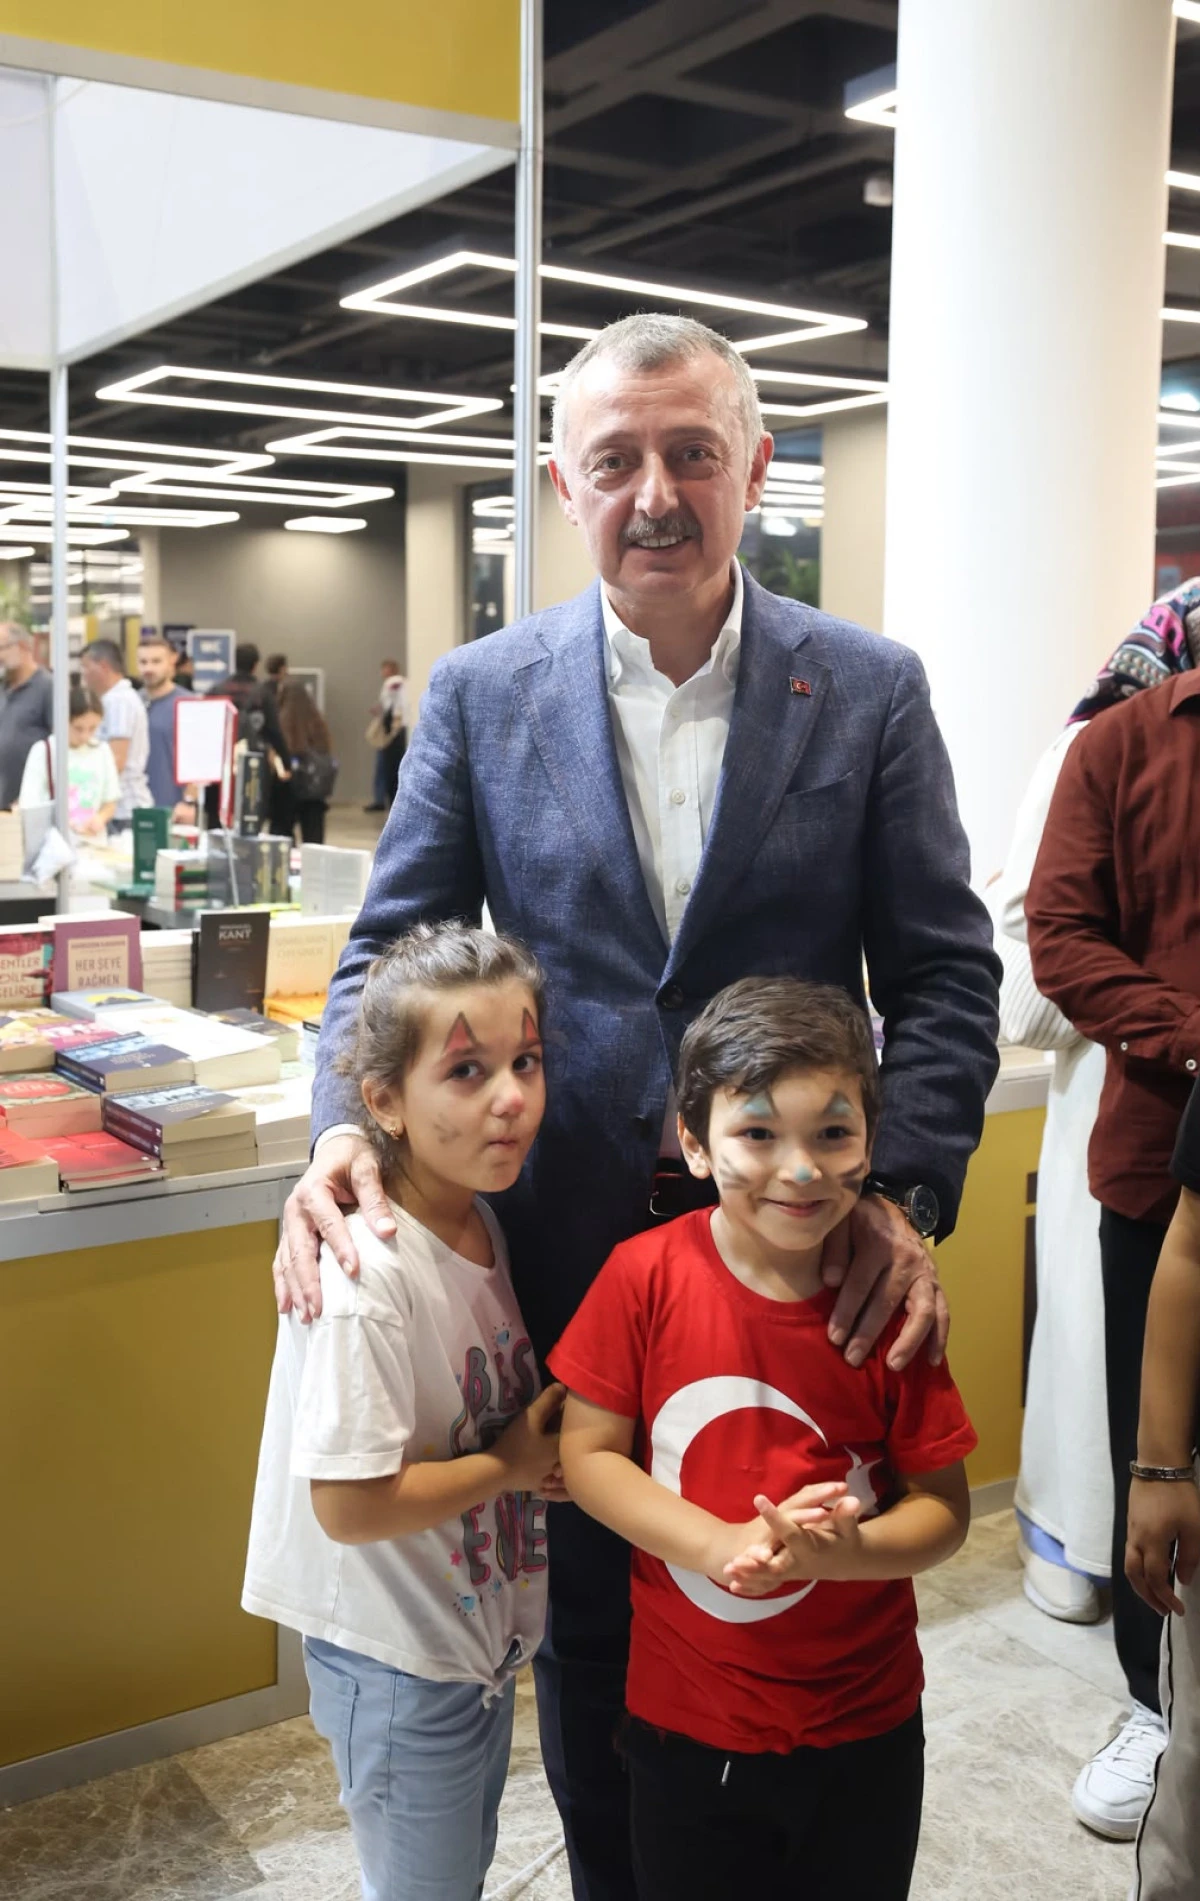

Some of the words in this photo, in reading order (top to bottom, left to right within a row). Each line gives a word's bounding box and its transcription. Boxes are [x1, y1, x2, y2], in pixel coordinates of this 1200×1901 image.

[219, 928, 252, 941] KANT
[75, 958, 95, 972] HER
[78, 972, 120, 988] RAĞMEN
